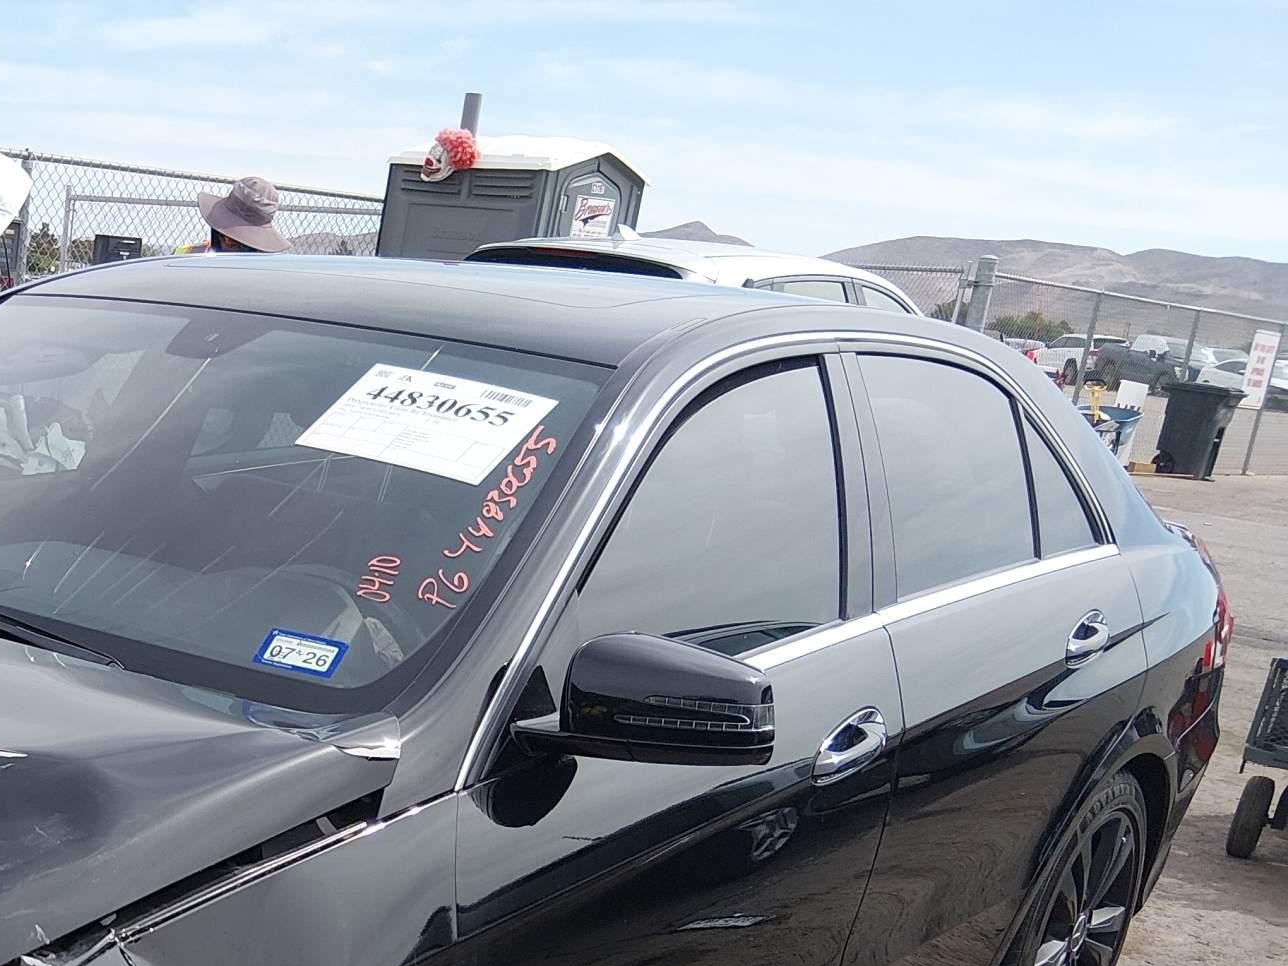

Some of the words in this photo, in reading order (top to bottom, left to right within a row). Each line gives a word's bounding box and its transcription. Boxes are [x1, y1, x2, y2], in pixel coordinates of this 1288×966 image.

[366, 386, 516, 427] 44830655
[270, 644, 296, 660] 07
[302, 651, 331, 668] 26
